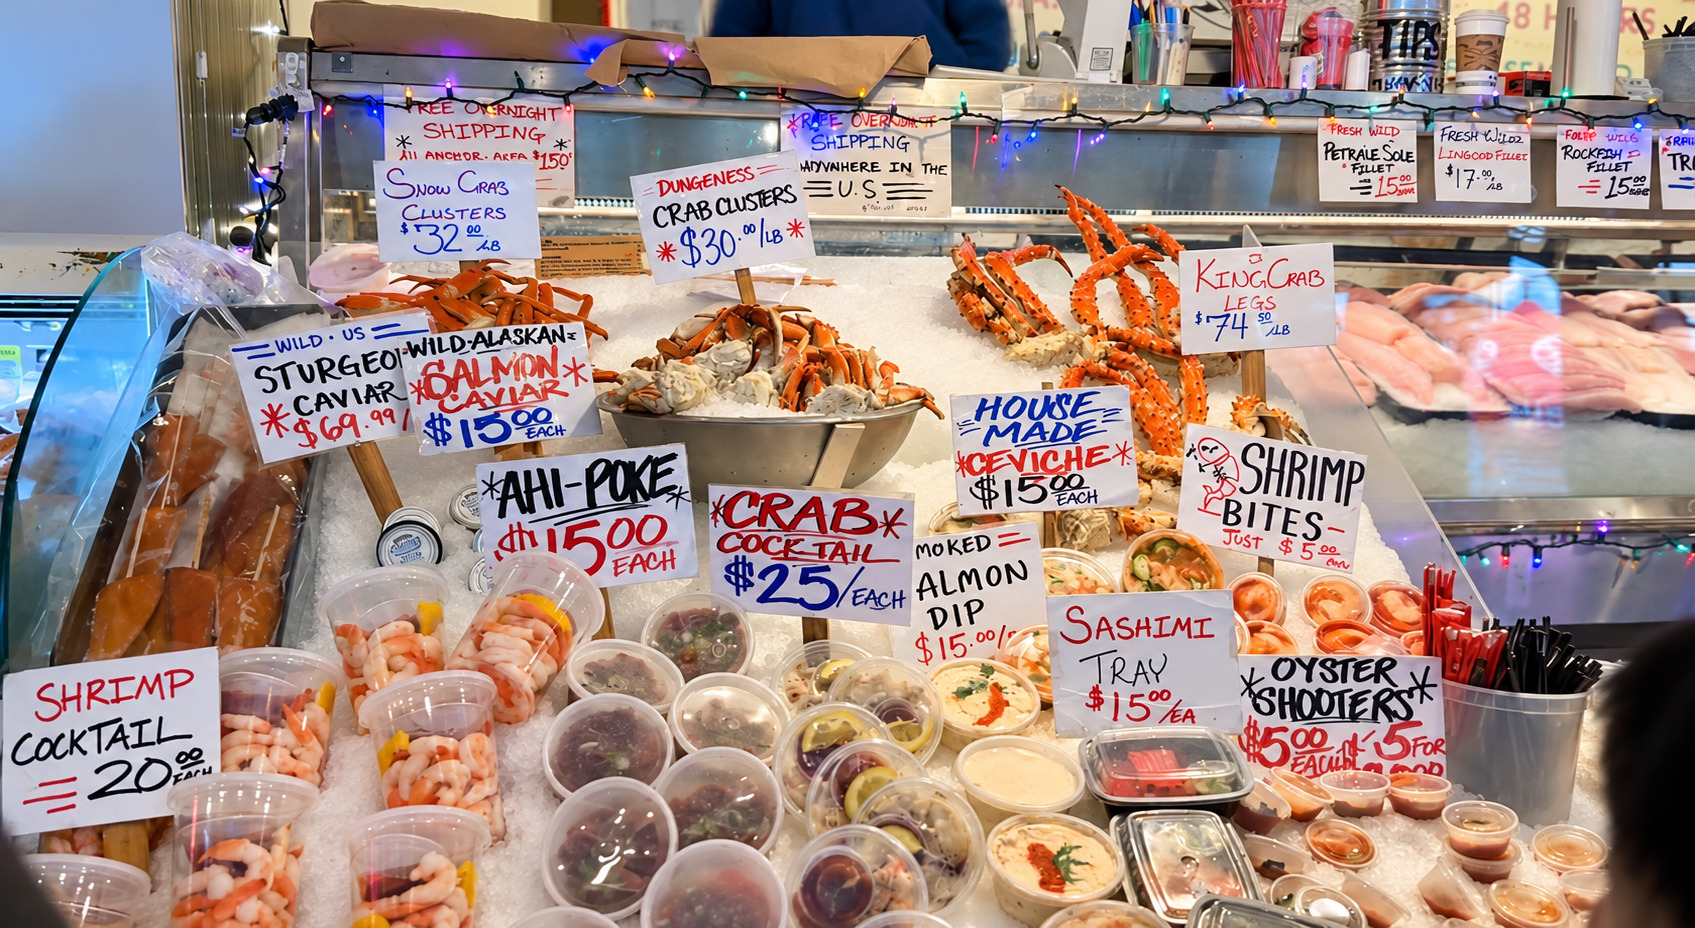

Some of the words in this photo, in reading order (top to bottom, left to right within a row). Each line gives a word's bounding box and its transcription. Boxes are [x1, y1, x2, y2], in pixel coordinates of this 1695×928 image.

[1377, 19, 1441, 61] TIPS
[423, 122, 546, 144] SHIPPING
[811, 134, 910, 152] SHIPPING
[1440, 125, 1479, 142] FRESH
[1382, 143, 1415, 163] SOLE
[1438, 146, 1493, 160] LINGCOD
[1495, 149, 1528, 161] FILLET
[1587, 161, 1632, 172] FILLET
[1667, 153, 1695, 171] TR
[656, 166, 755, 197] DUNGENESS
[889, 162, 912, 173] IN
[922, 163, 948, 176] THE
[1351, 163, 1395, 175] FILLET
[402, 204, 506, 221] CLUSTERS
[652, 200, 712, 228] CRAB
[716, 184, 797, 216] CLUSTERS
[1224, 295, 1276, 312] LEGS
[274, 334, 323, 353] WILD
[342, 327, 365, 341] US
[421, 344, 558, 400] SALMON
[293, 381, 408, 417] CAVIAR
[438, 380, 569, 413] CAVIAR
[974, 391, 1106, 422] HOUSE
[525, 424, 567, 439] EACH
[982, 419, 1107, 447] MADE
[966, 445, 1112, 476] CEVICHE
[1239, 442, 1365, 507] SHRIMP
[1055, 489, 1098, 506] EACH
[722, 491, 879, 535] CRAB
[1222, 498, 1324, 542] BITES
[915, 534, 991, 560] MOKED
[1222, 528, 1264, 549] JUST
[612, 548, 677, 577] EACH
[916, 560, 1028, 601] ALMON
[926, 599, 984, 631] DIP
[1059, 605, 1215, 645] SASHIMI
[1079, 649, 1168, 687] TRAY
[1271, 657, 1398, 687] OYSTER
[35, 669, 195, 722] SHRIMP
[1252, 686, 1414, 723] SHOOTERS
[11, 716, 193, 766] COCKTAIL
